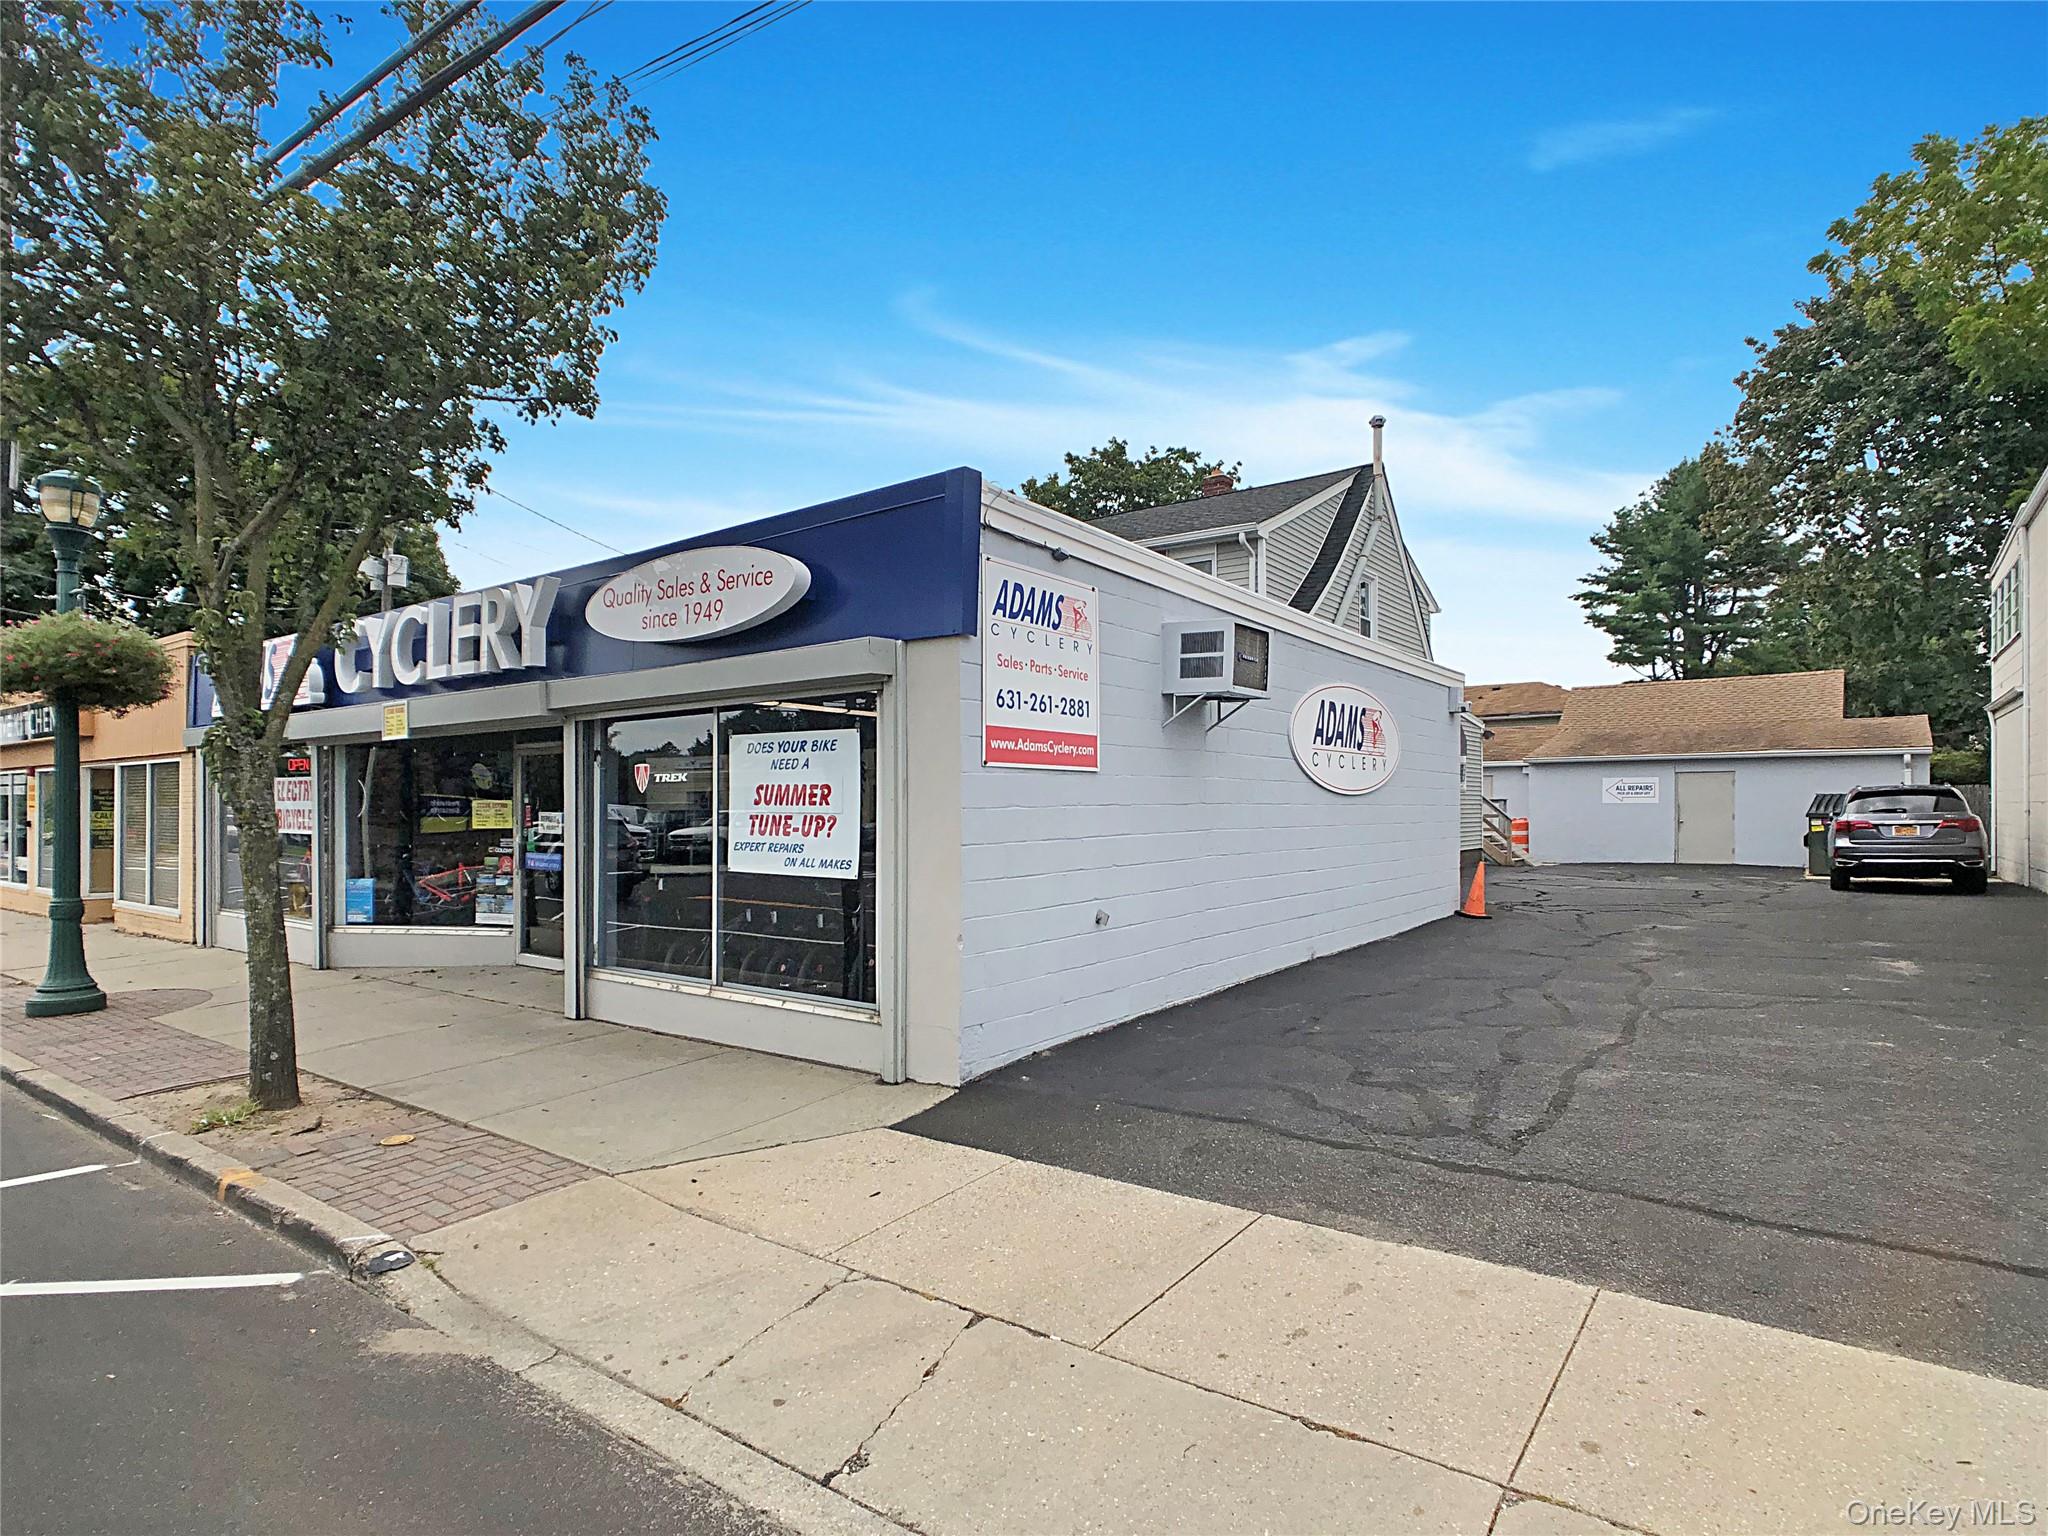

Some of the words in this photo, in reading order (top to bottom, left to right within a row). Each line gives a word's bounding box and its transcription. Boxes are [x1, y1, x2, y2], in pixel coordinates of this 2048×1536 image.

[603, 582, 652, 608] Quality
[657, 579, 694, 600] Sales
[700, 572, 711, 594] &
[717, 564, 774, 592] Service
[641, 608, 678, 630] since
[684, 598, 724, 626] 1949
[992, 578, 1064, 631] ADAMS
[334, 576, 561, 693] CYCLERY
[990, 622, 1093, 655] CYCLERY
[996, 653, 1024, 671] Sales
[1029, 660, 1053, 676] Parts
[1058, 664, 1089, 682] Service
[996, 688, 1090, 718] 631-261-2881
[1312, 699, 1367, 751] ADAMS
[747, 741, 774, 754] DOES
[777, 740, 807, 753] YOUR
[811, 739, 838, 752] BIKE
[990, 737, 1094, 757] www.AdamsCyclery.com
[288, 759, 310, 771] OPEN
[770, 758, 798, 770] NEED
[801, 757, 810, 770] A
[1311, 752, 1387, 772] CYCLERY
[654, 773, 688, 783] TREK
[276, 780, 312, 802] ELECTR
[753, 783, 832, 807] SUMMER
[749, 814, 838, 839] TUNE-UP?
[734, 841, 766, 852] EXPERT
[768, 842, 804, 854] REPAIRS
[784, 857, 798, 868] ON
[800, 857, 816, 868] ALL
[820, 859, 852, 870] MAKES
